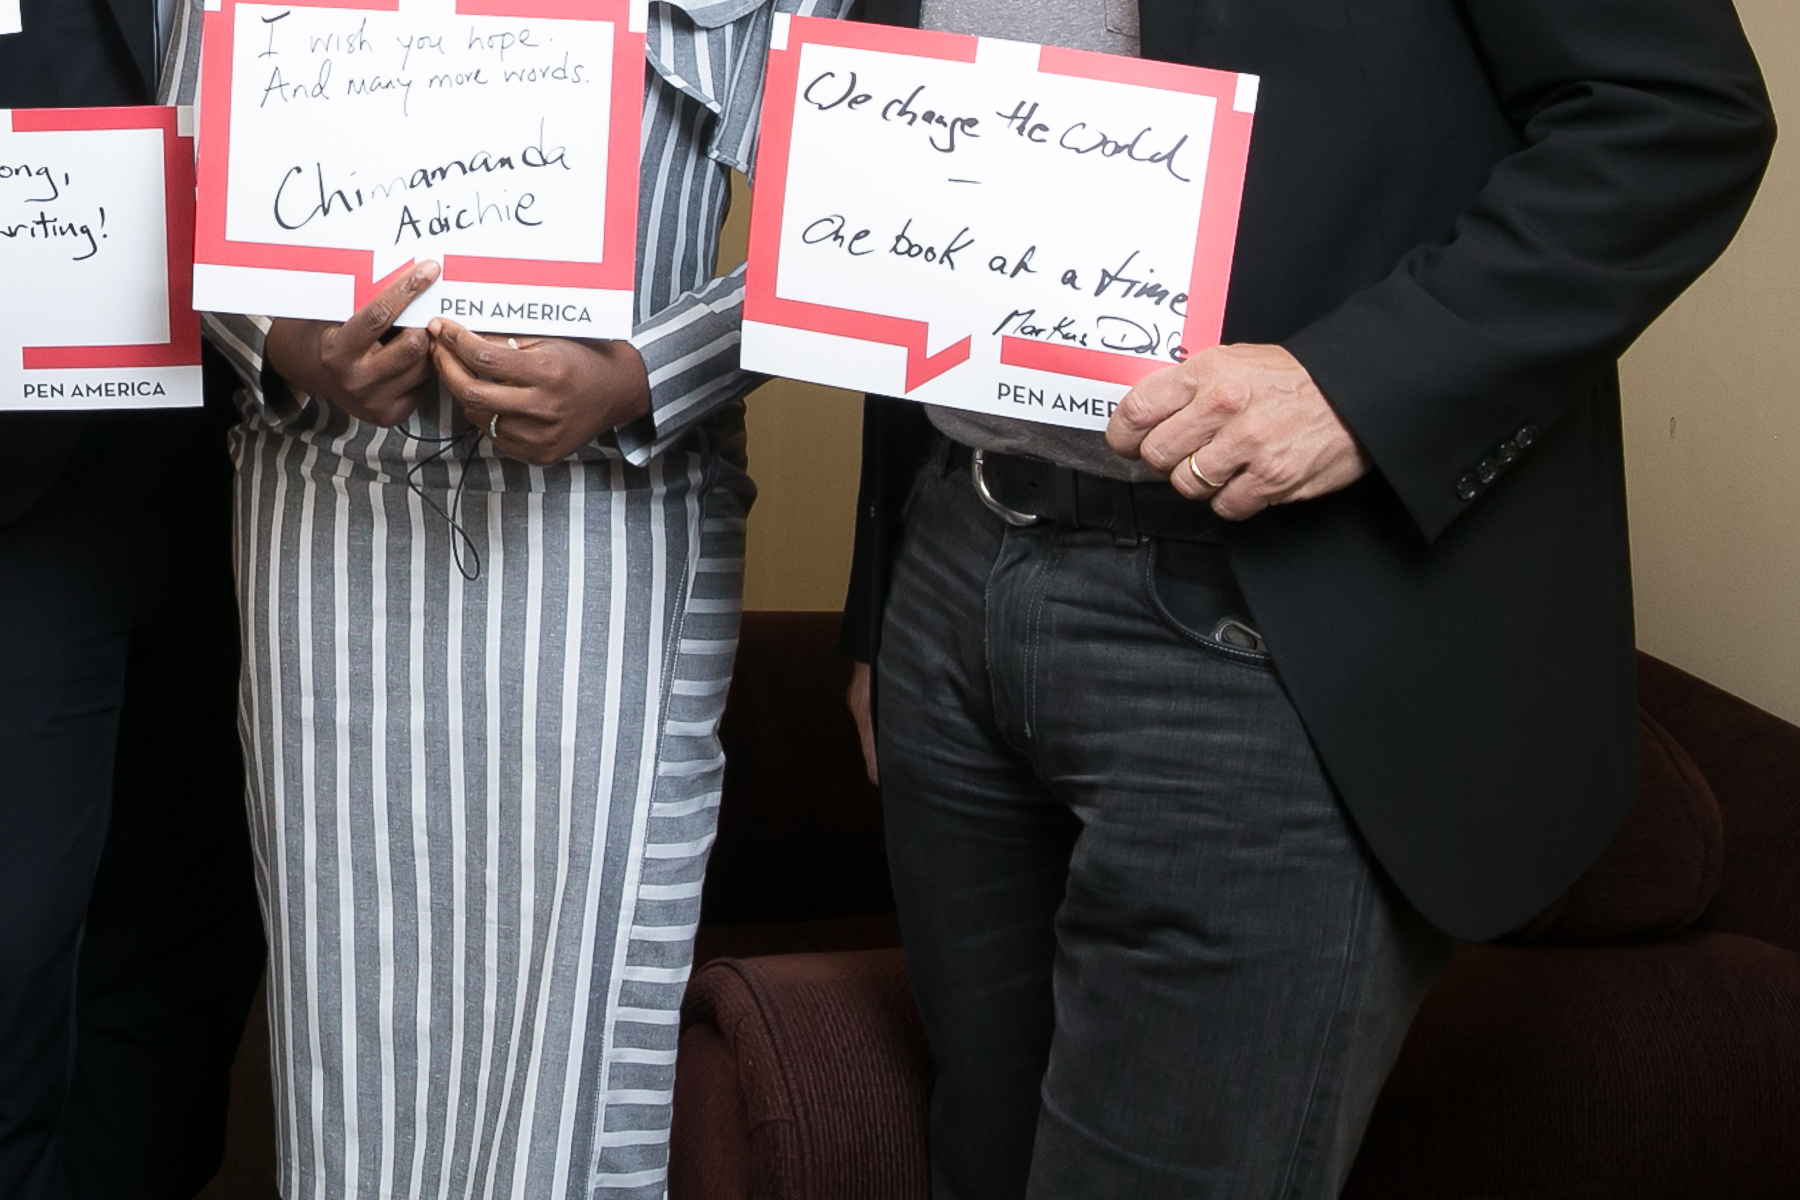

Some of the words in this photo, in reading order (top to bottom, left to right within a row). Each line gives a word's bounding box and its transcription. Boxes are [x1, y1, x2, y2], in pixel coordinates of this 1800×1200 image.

[257, 10, 292, 59] I
[309, 17, 373, 55] wish
[397, 34, 446, 71] you
[260, 58, 331, 108] And
[347, 74, 413, 117] many
[428, 68, 489, 89] more
[503, 51, 590, 85] words.
[803, 71, 873, 111] We
[881, 85, 980, 153] change
[996, 100, 1050, 143] the
[1059, 121, 1192, 183] world
[273, 117, 571, 231] Chimamanda
[394, 191, 543, 246] Adichie
[801, 213, 875, 256] One
[888, 218, 975, 271] book
[988, 245, 1037, 279] at
[1060, 267, 1082, 291] a
[1093, 249, 1189, 319] time
[440, 297, 484, 317] PEN
[490, 301, 593, 324] AMERICA
[991, 307, 1088, 347] Markus
[23, 382, 64, 400] PEN
[70, 380, 167, 399] AMERICA
[997, 382, 1044, 407] PEN
